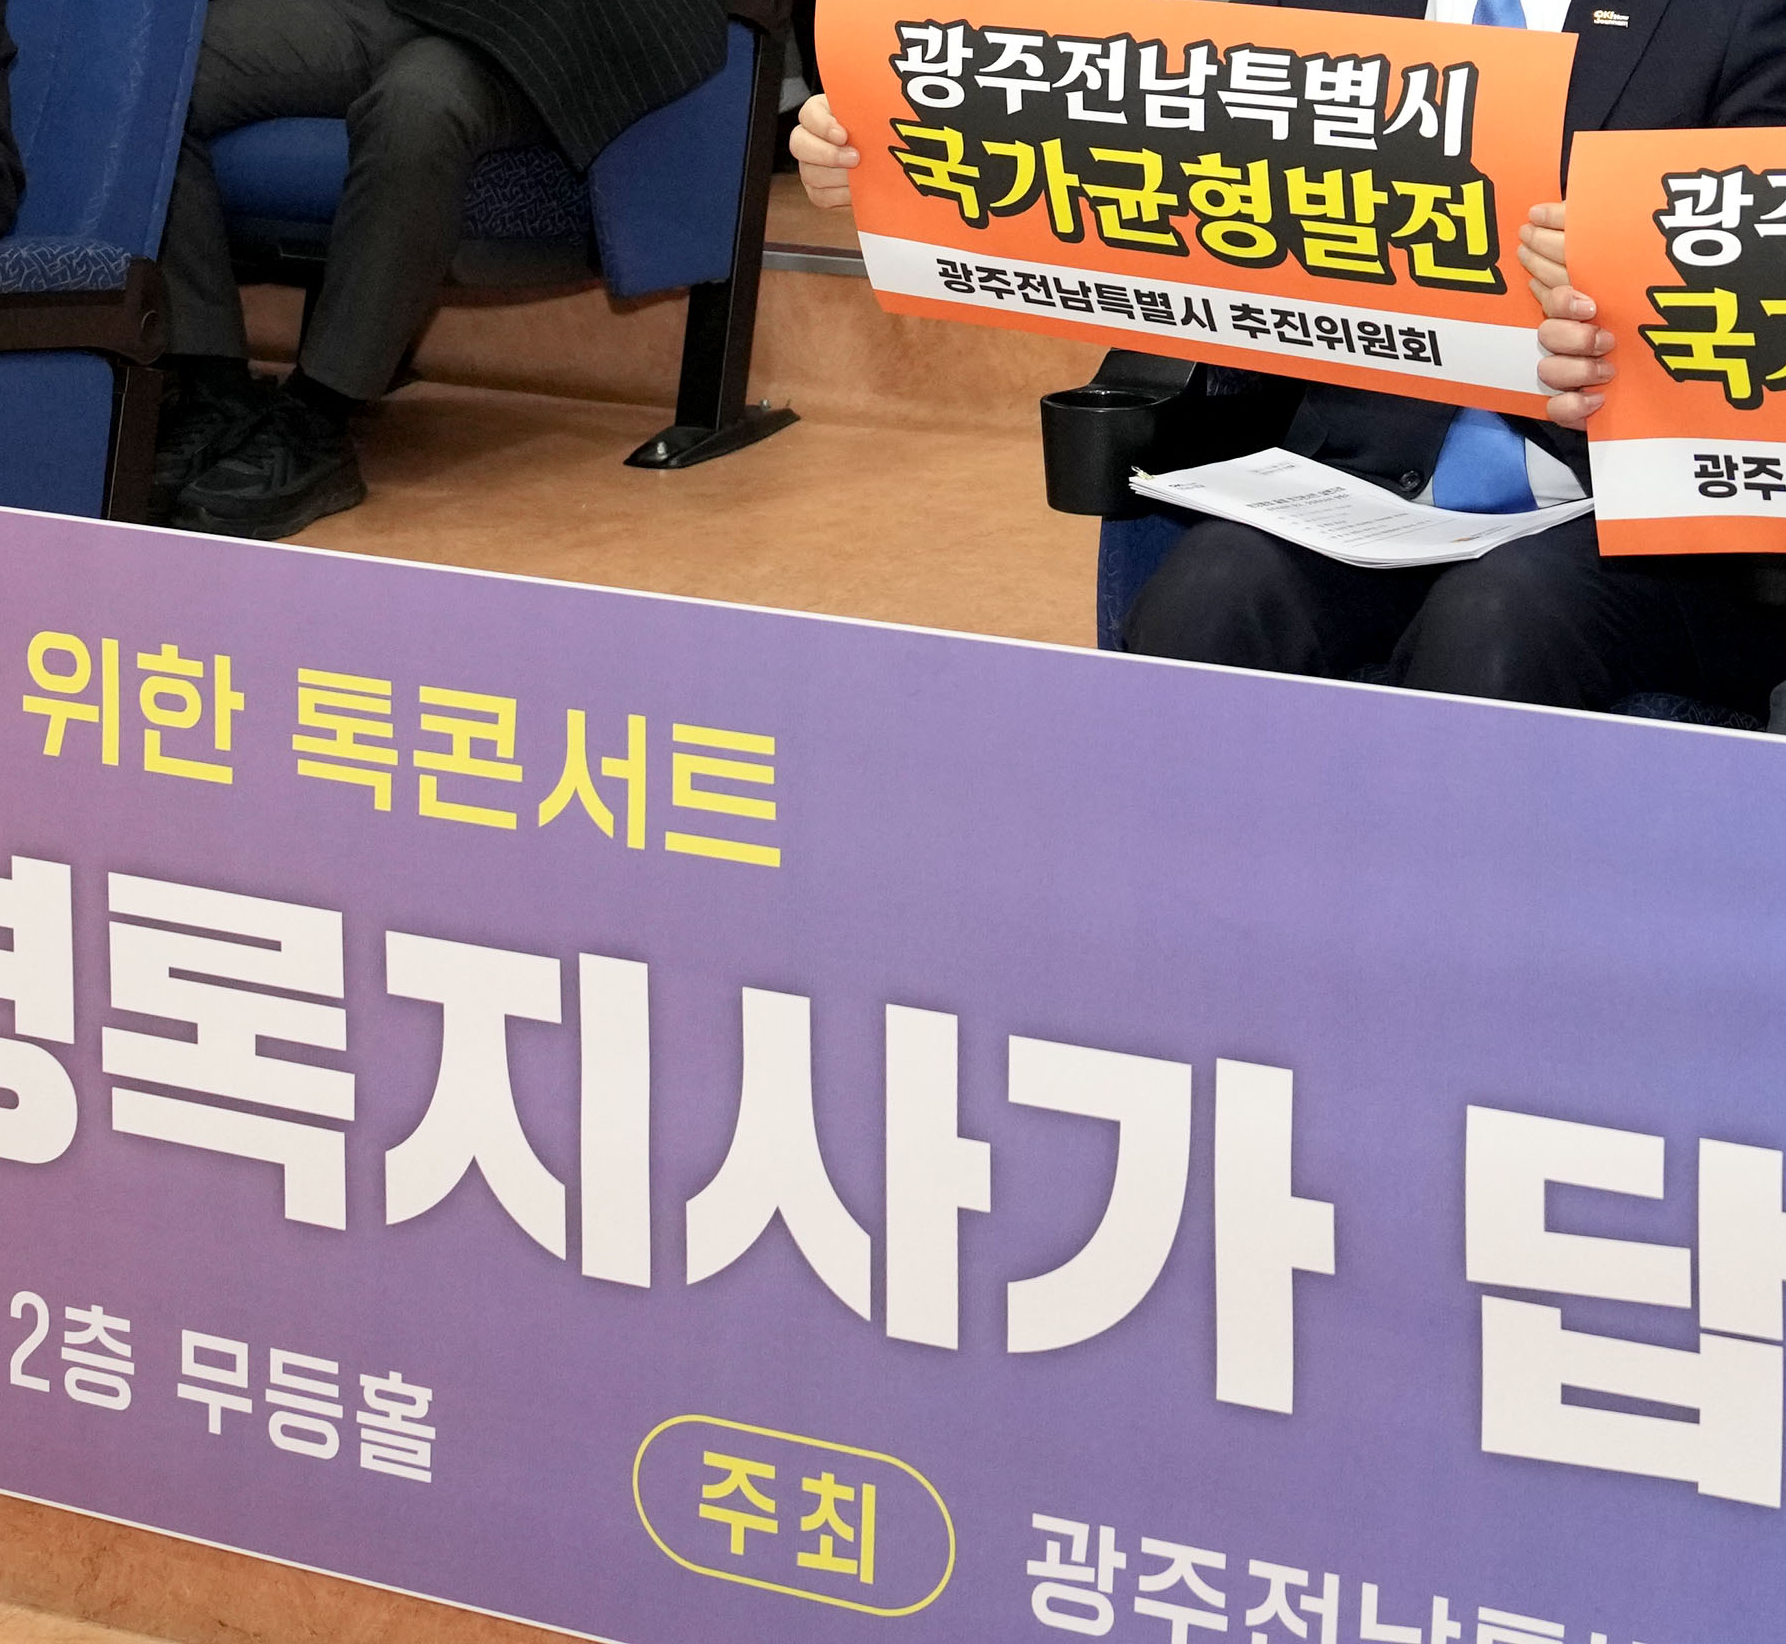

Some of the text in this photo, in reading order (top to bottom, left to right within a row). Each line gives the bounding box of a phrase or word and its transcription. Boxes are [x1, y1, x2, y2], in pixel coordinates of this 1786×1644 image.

[894, 23, 1471, 157] 광주전남특별시
[895, 122, 1496, 285] 국가균형발전
[936, 258, 1444, 368] 광주전남특별시 추진위원회
[23, 629, 244, 786] 위한
[289, 667, 783, 869] 톡콘서트
[8, 1288, 137, 1413] 2층
[174, 1328, 440, 1484] 무등홀
[698, 1450, 877, 1586] 주최
